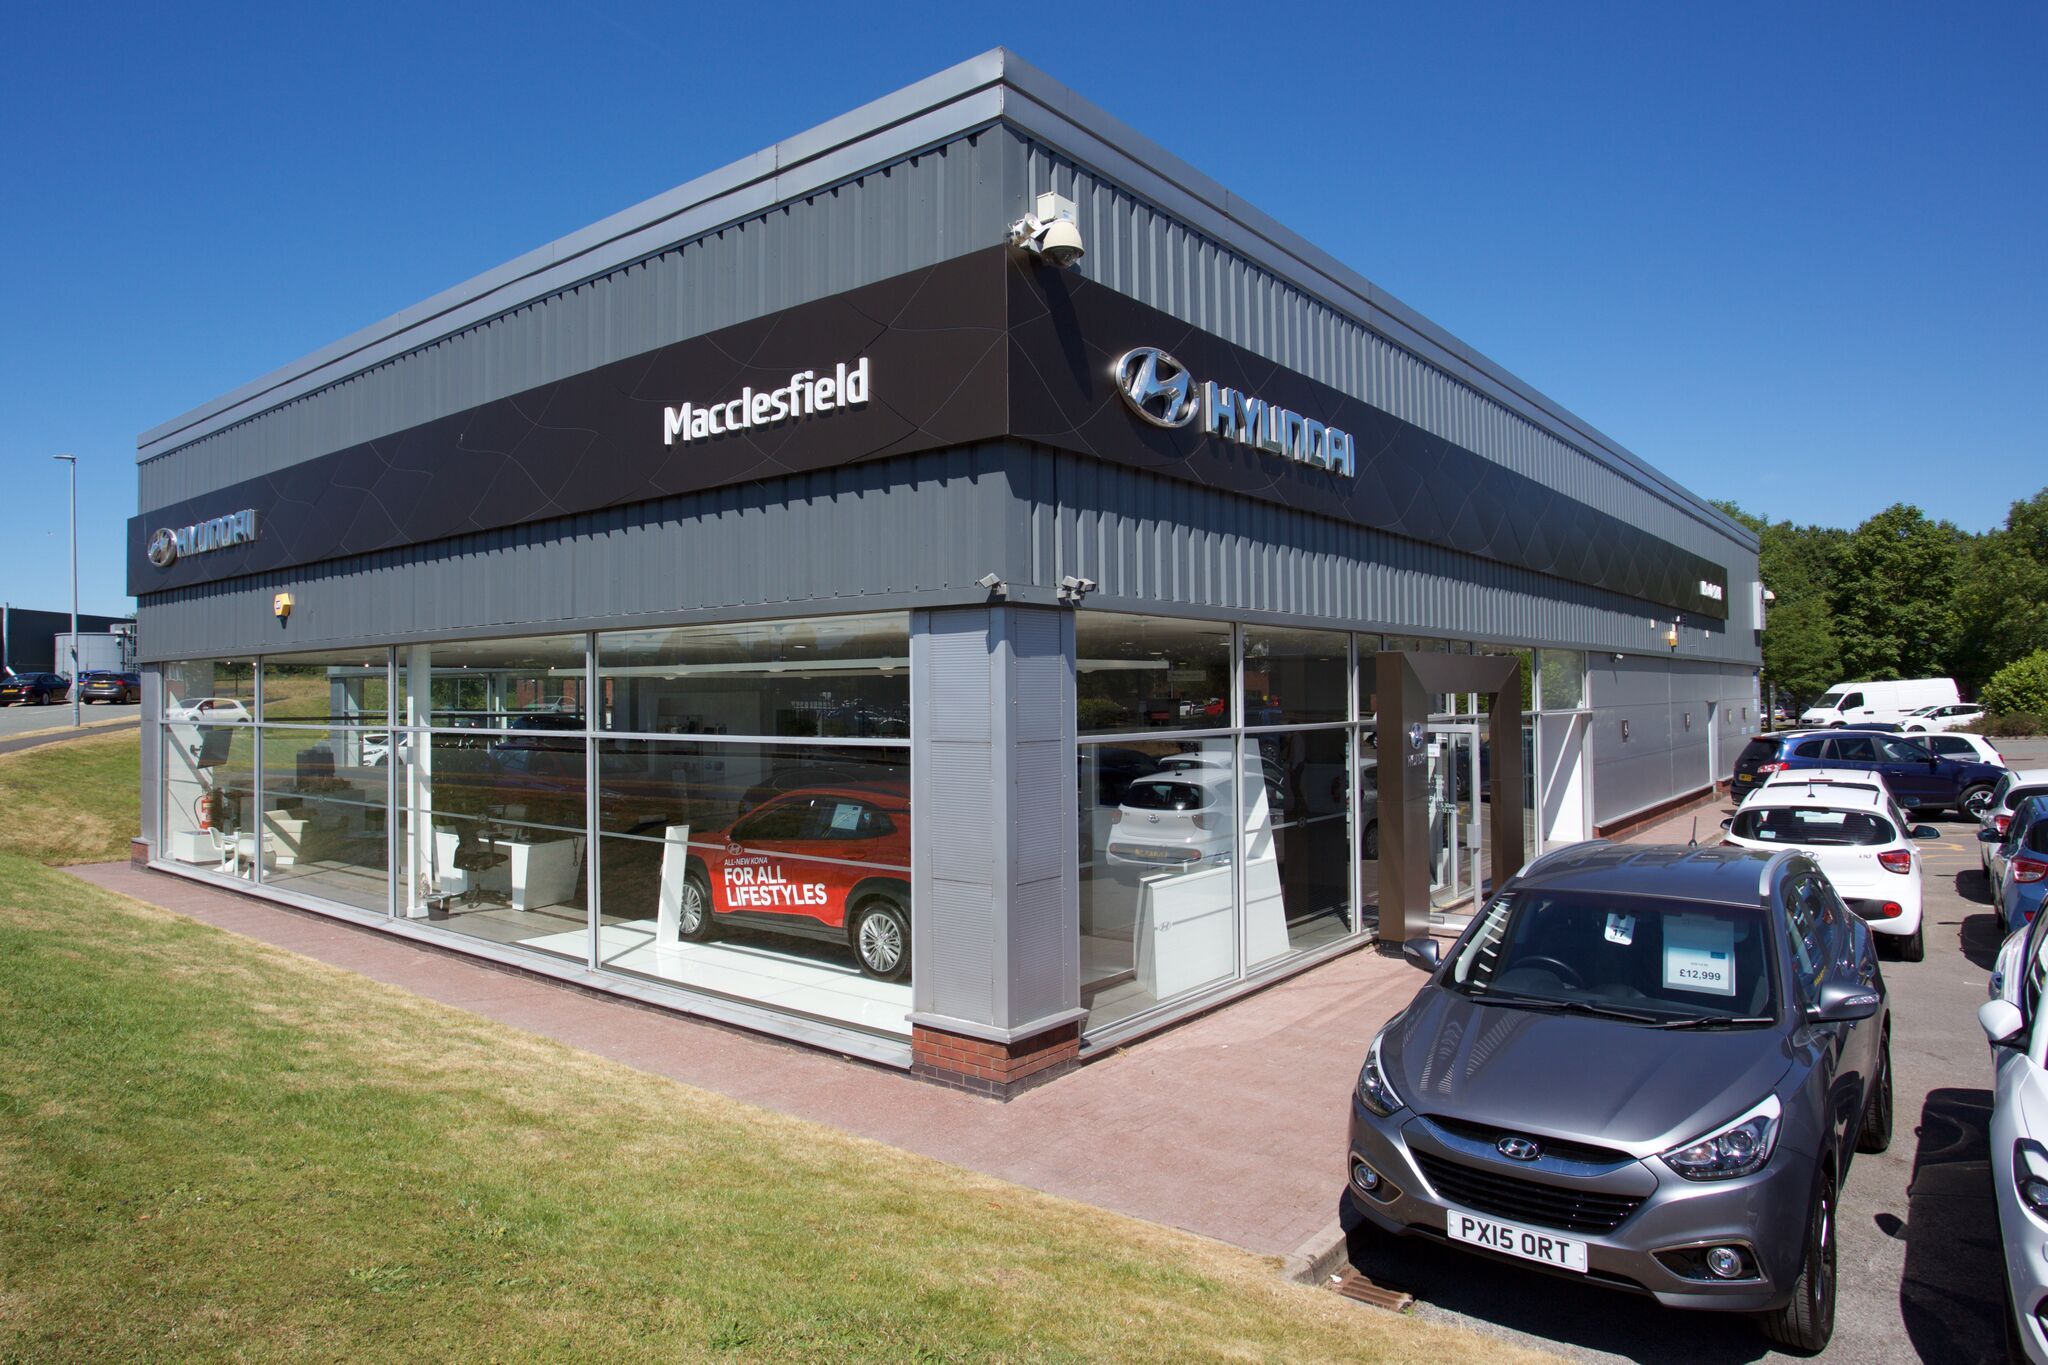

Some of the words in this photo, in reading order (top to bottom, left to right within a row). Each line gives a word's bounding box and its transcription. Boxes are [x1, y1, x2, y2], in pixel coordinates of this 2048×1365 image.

[664, 357, 869, 445] Macclesfield
[1204, 380, 1355, 478] HYUNDAI
[176, 508, 255, 558] HYUNDAI
[724, 858, 750, 866] ALL-NEW
[724, 867, 756, 886] FOR
[757, 865, 787, 884] ALL
[726, 883, 828, 907] LIFESTYLES
[1612, 929, 1626, 938] 17
[1679, 968, 1721, 981] £12,999
[1461, 1216, 1514, 1250] PX15
[1521, 1233, 1570, 1264] ORT
